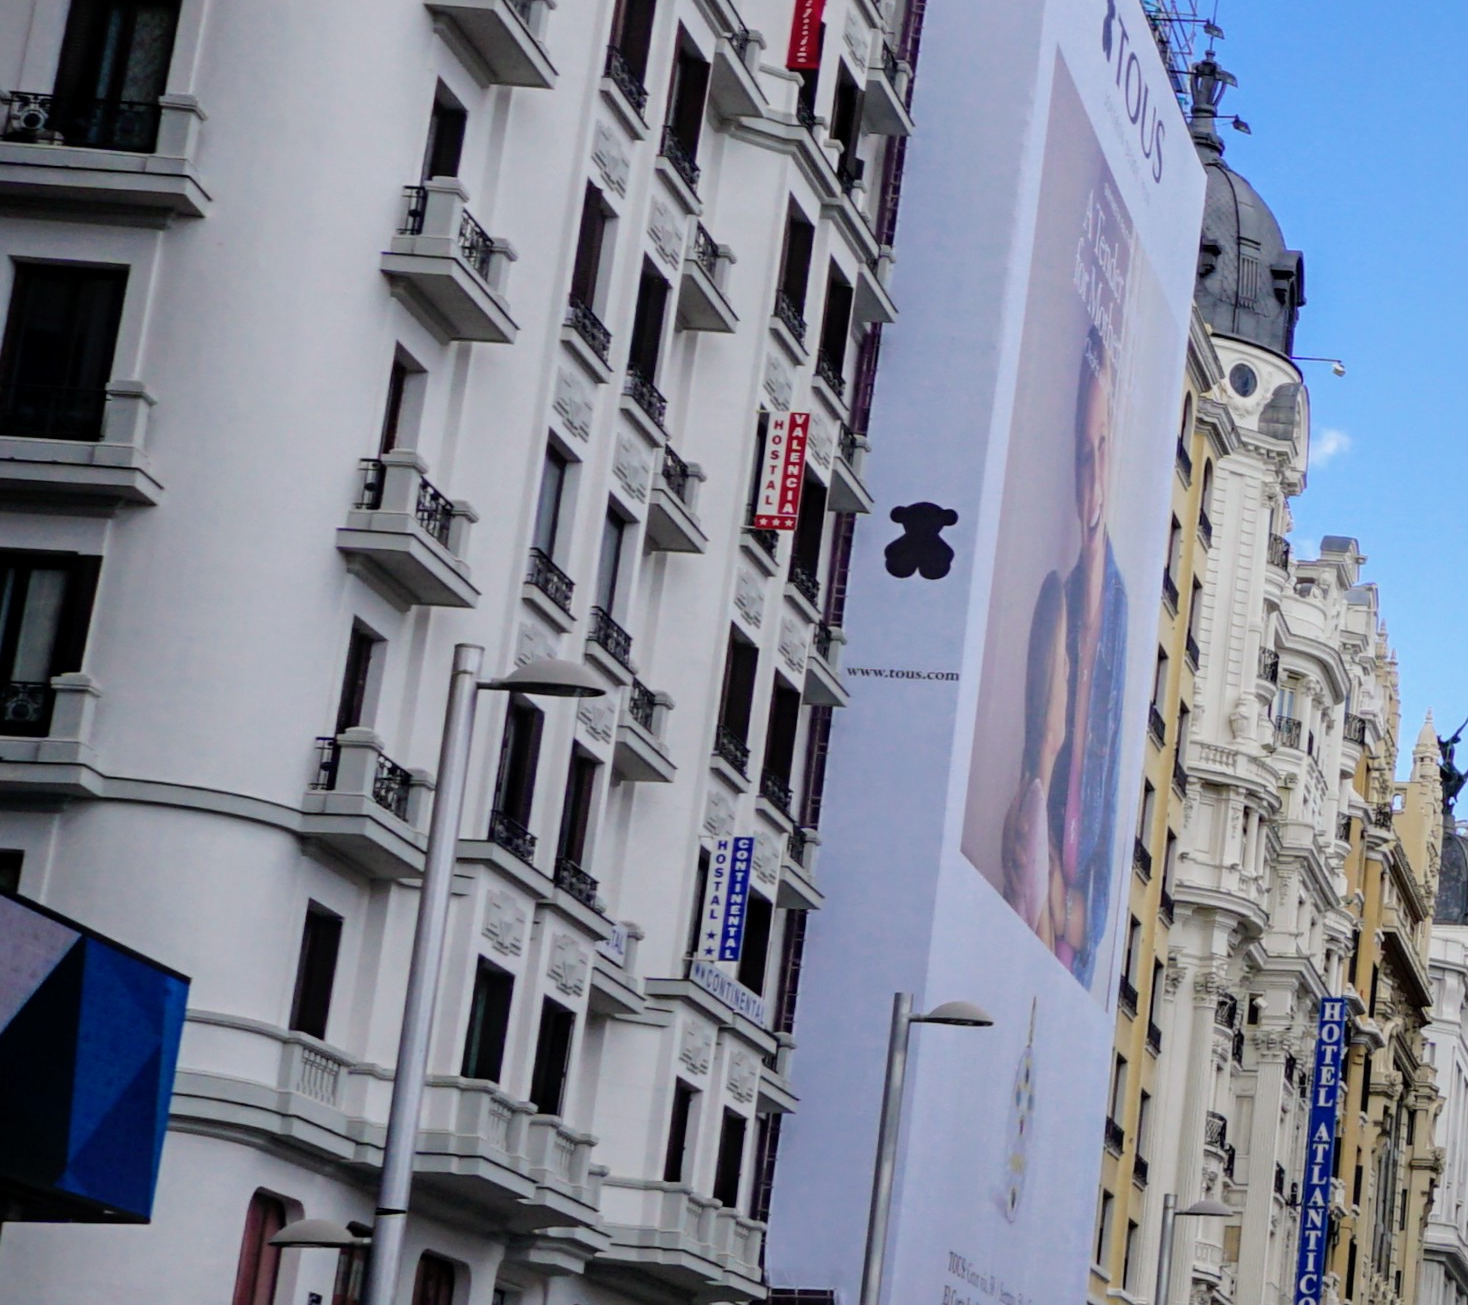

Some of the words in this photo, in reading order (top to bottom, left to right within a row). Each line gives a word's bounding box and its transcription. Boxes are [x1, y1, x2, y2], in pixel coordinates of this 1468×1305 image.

[1115, 13, 1166, 184] TOUS
[764, 419, 785, 506] HOSTAL
[781, 414, 807, 514] VALENCIA
[846, 667, 960, 682] www.tous.com
[709, 840, 728, 920] HOSTAL
[724, 839, 750, 959] CONTINENTAL
[706, 966, 766, 1026] CONTINENTAL
[1318, 1002, 1343, 1108] HOTEL
